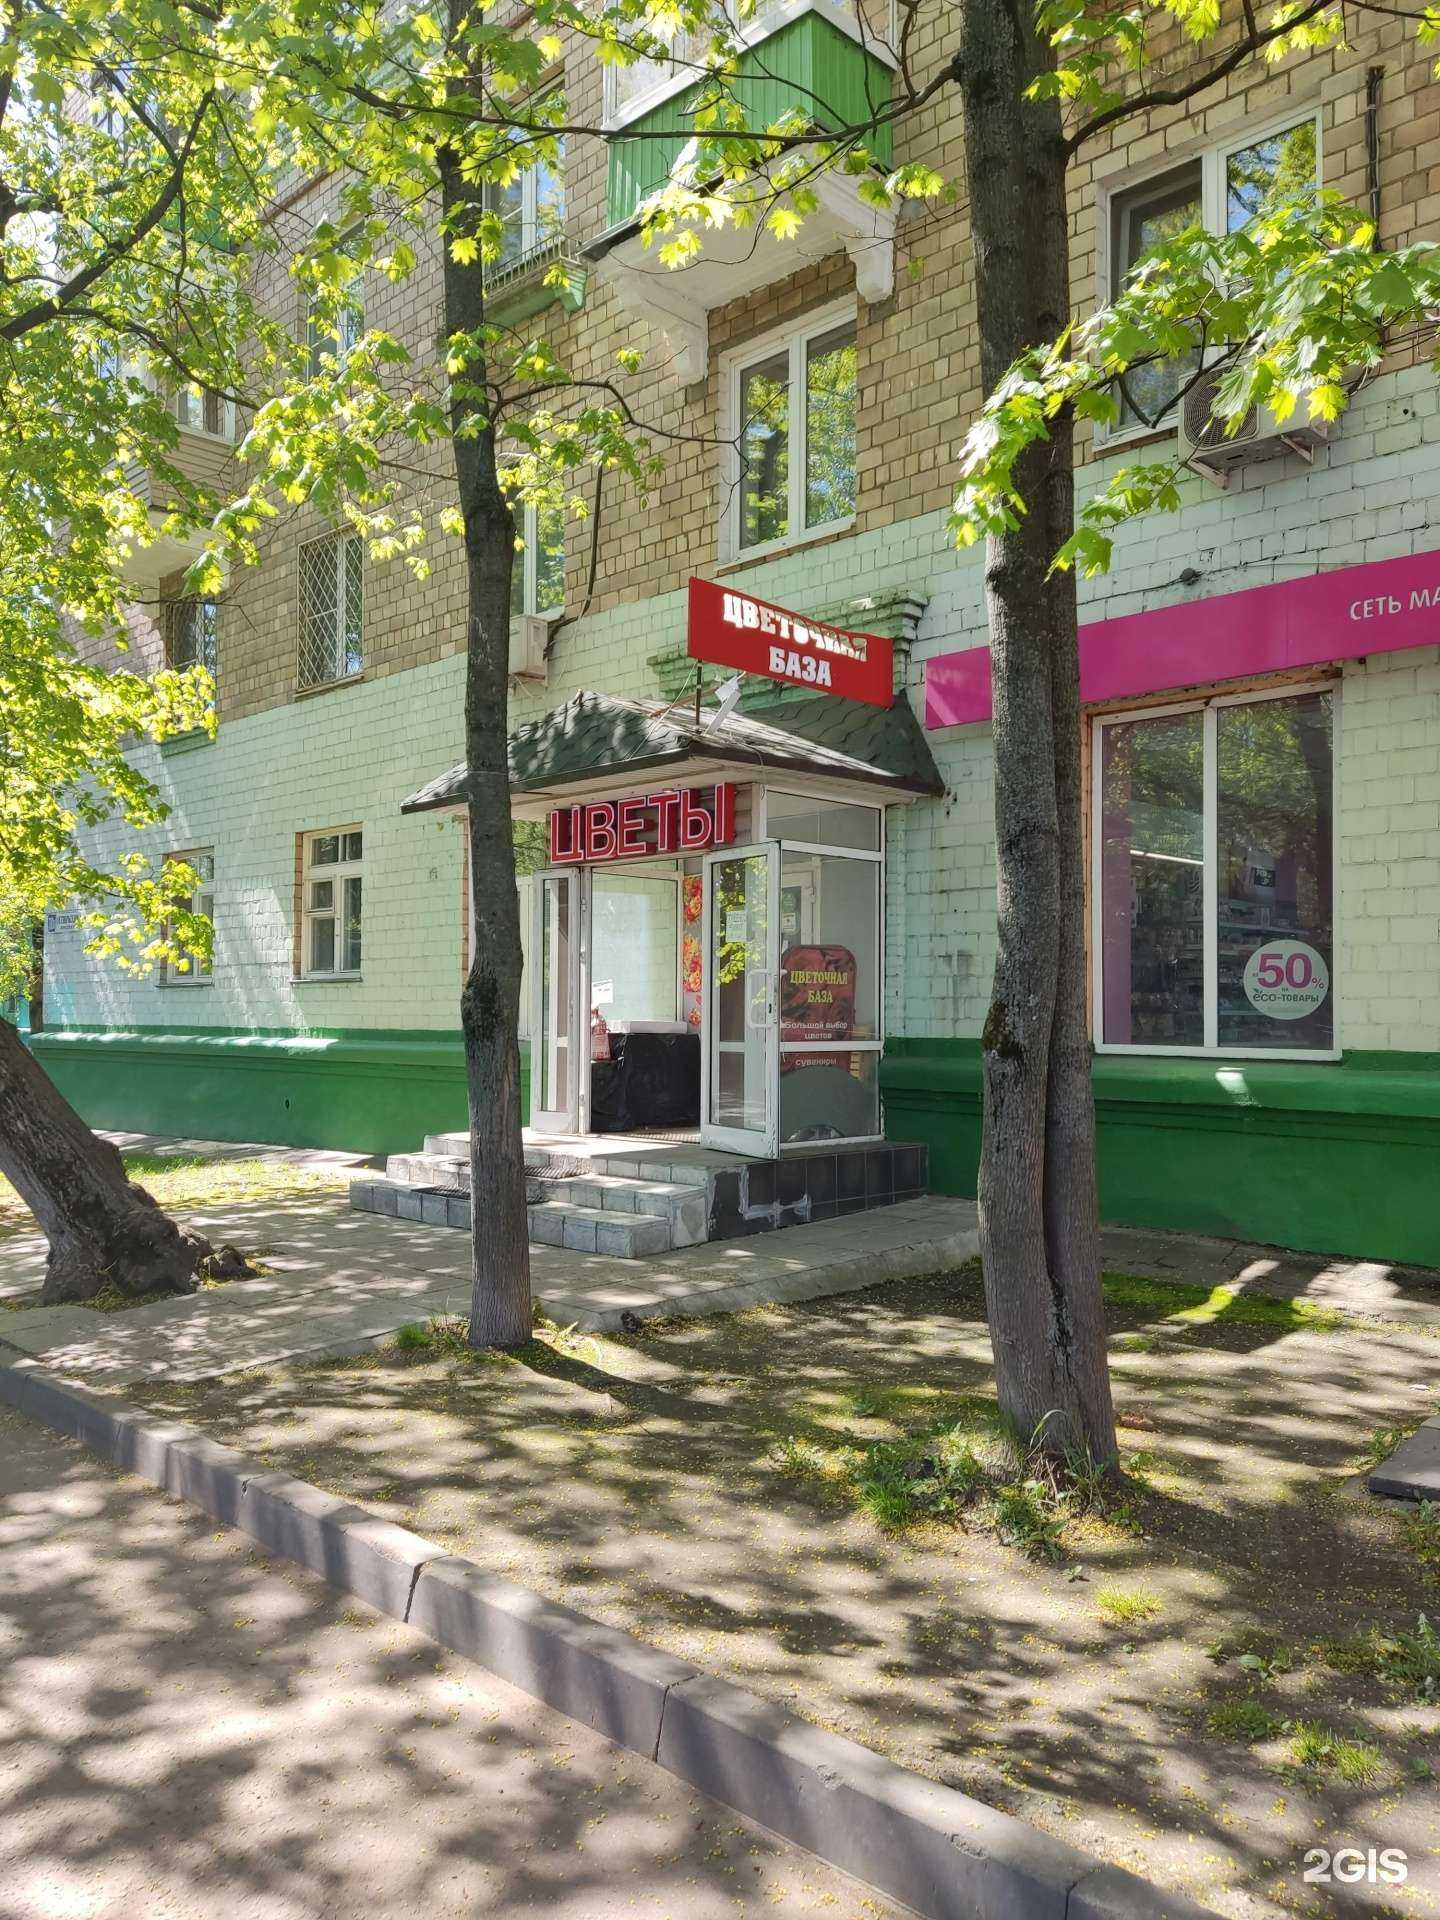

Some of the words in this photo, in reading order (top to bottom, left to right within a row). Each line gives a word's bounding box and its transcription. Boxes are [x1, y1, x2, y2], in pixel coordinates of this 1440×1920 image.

[1350, 595, 1402, 620] СЕТЬ
[723, 592, 868, 662] ЦВЕТОЧНАЯ
[768, 645, 832, 687] БАЗА
[551, 783, 727, 863] ЦВЕТЫ
[790, 970, 848, 985] ЦВЕТОЧНАЯ
[807, 990, 833, 1003] БАЗА
